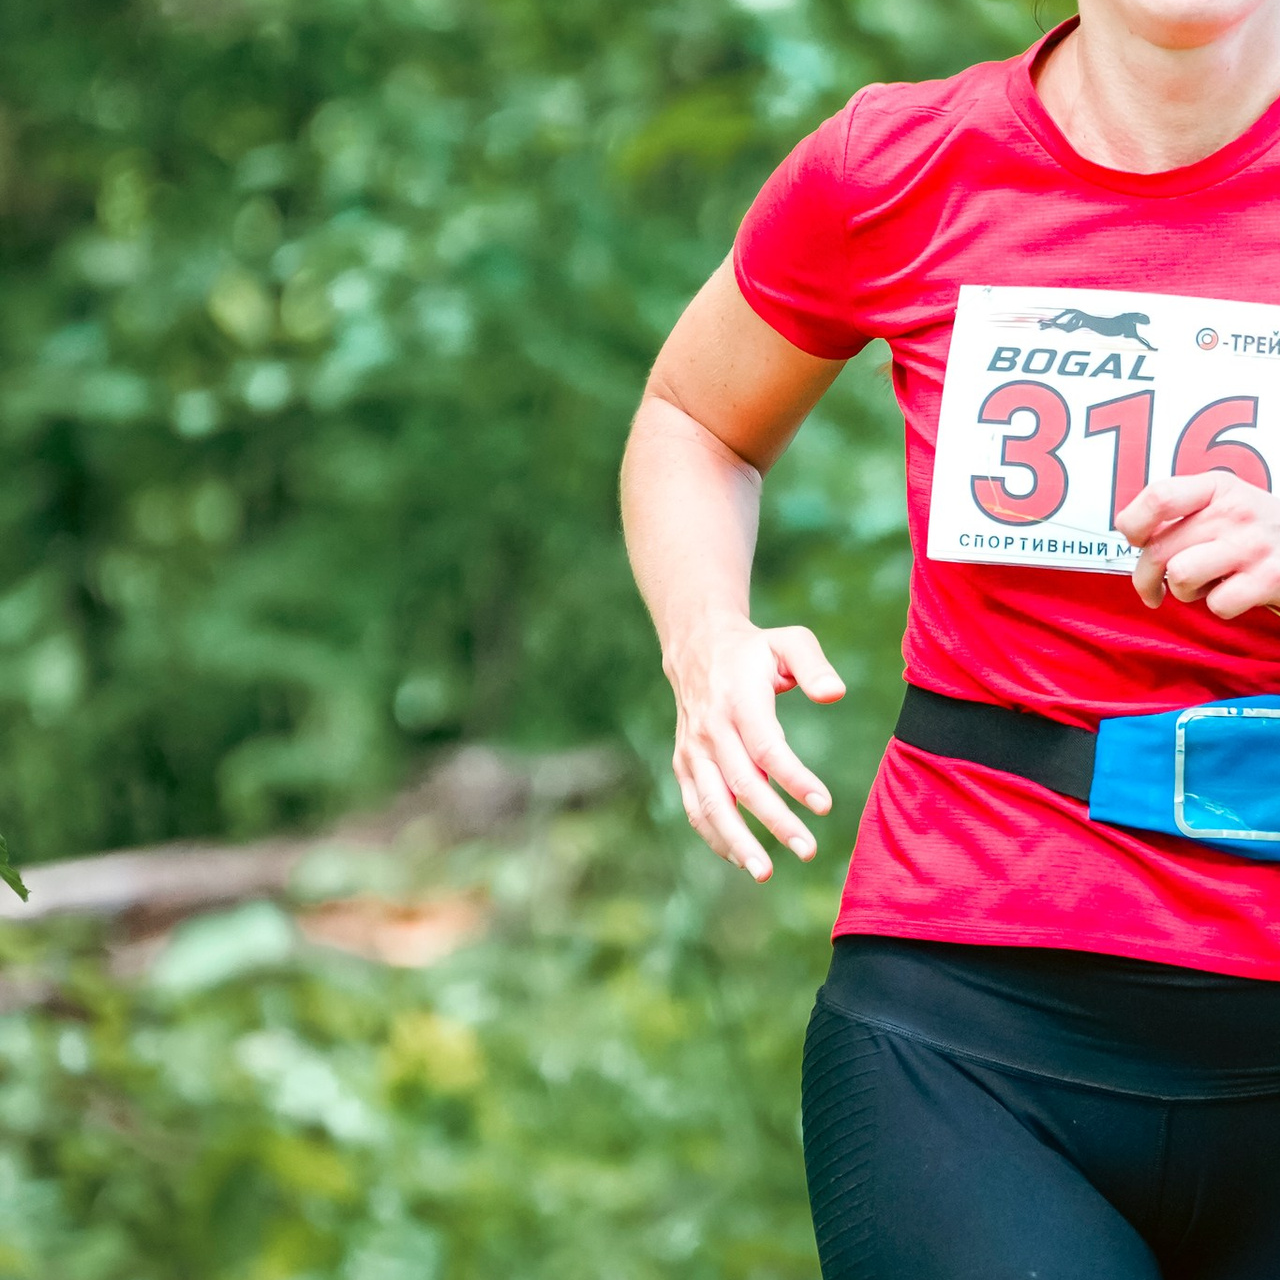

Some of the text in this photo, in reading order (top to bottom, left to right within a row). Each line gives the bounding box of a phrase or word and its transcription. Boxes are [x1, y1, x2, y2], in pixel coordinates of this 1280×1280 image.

[986, 346, 1156, 382] BOGAL
[969, 379, 1273, 532] 316
[959, 533, 1108, 556] СПОРТИВНЫЙ
